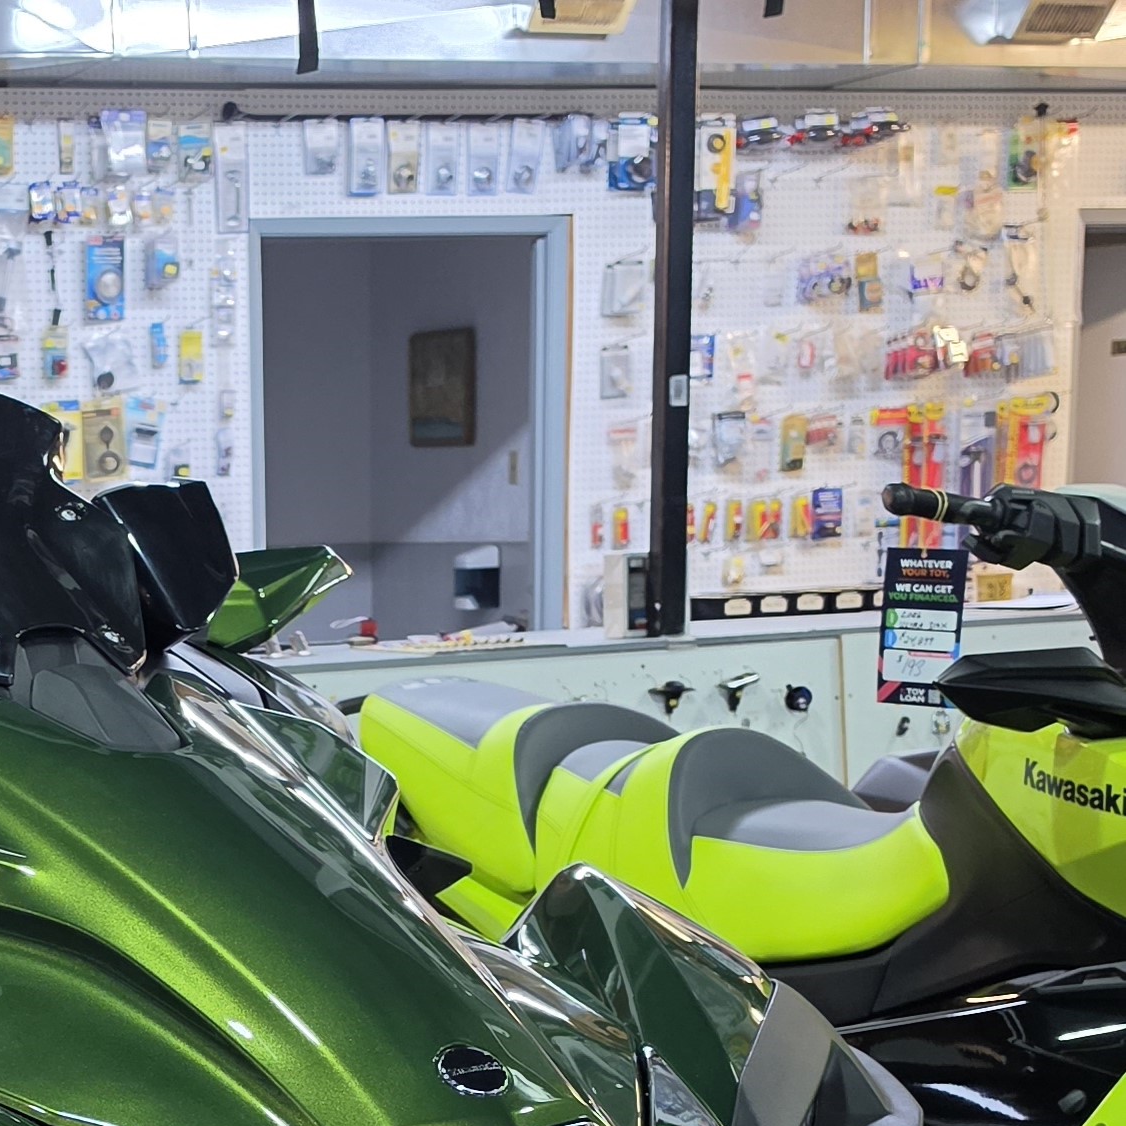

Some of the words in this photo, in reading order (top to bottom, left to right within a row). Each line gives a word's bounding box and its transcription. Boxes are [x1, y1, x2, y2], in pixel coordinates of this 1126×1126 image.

[900, 559, 953, 569] WHATEVER
[902, 568, 927, 577] YOUR
[895, 583, 911, 592] WE
[912, 583, 933, 593] CAN
[934, 584, 954, 594] GET
[888, 591, 907, 601] YOU
[906, 687, 925, 696] TOY
[899, 694, 925, 703] LOAN
